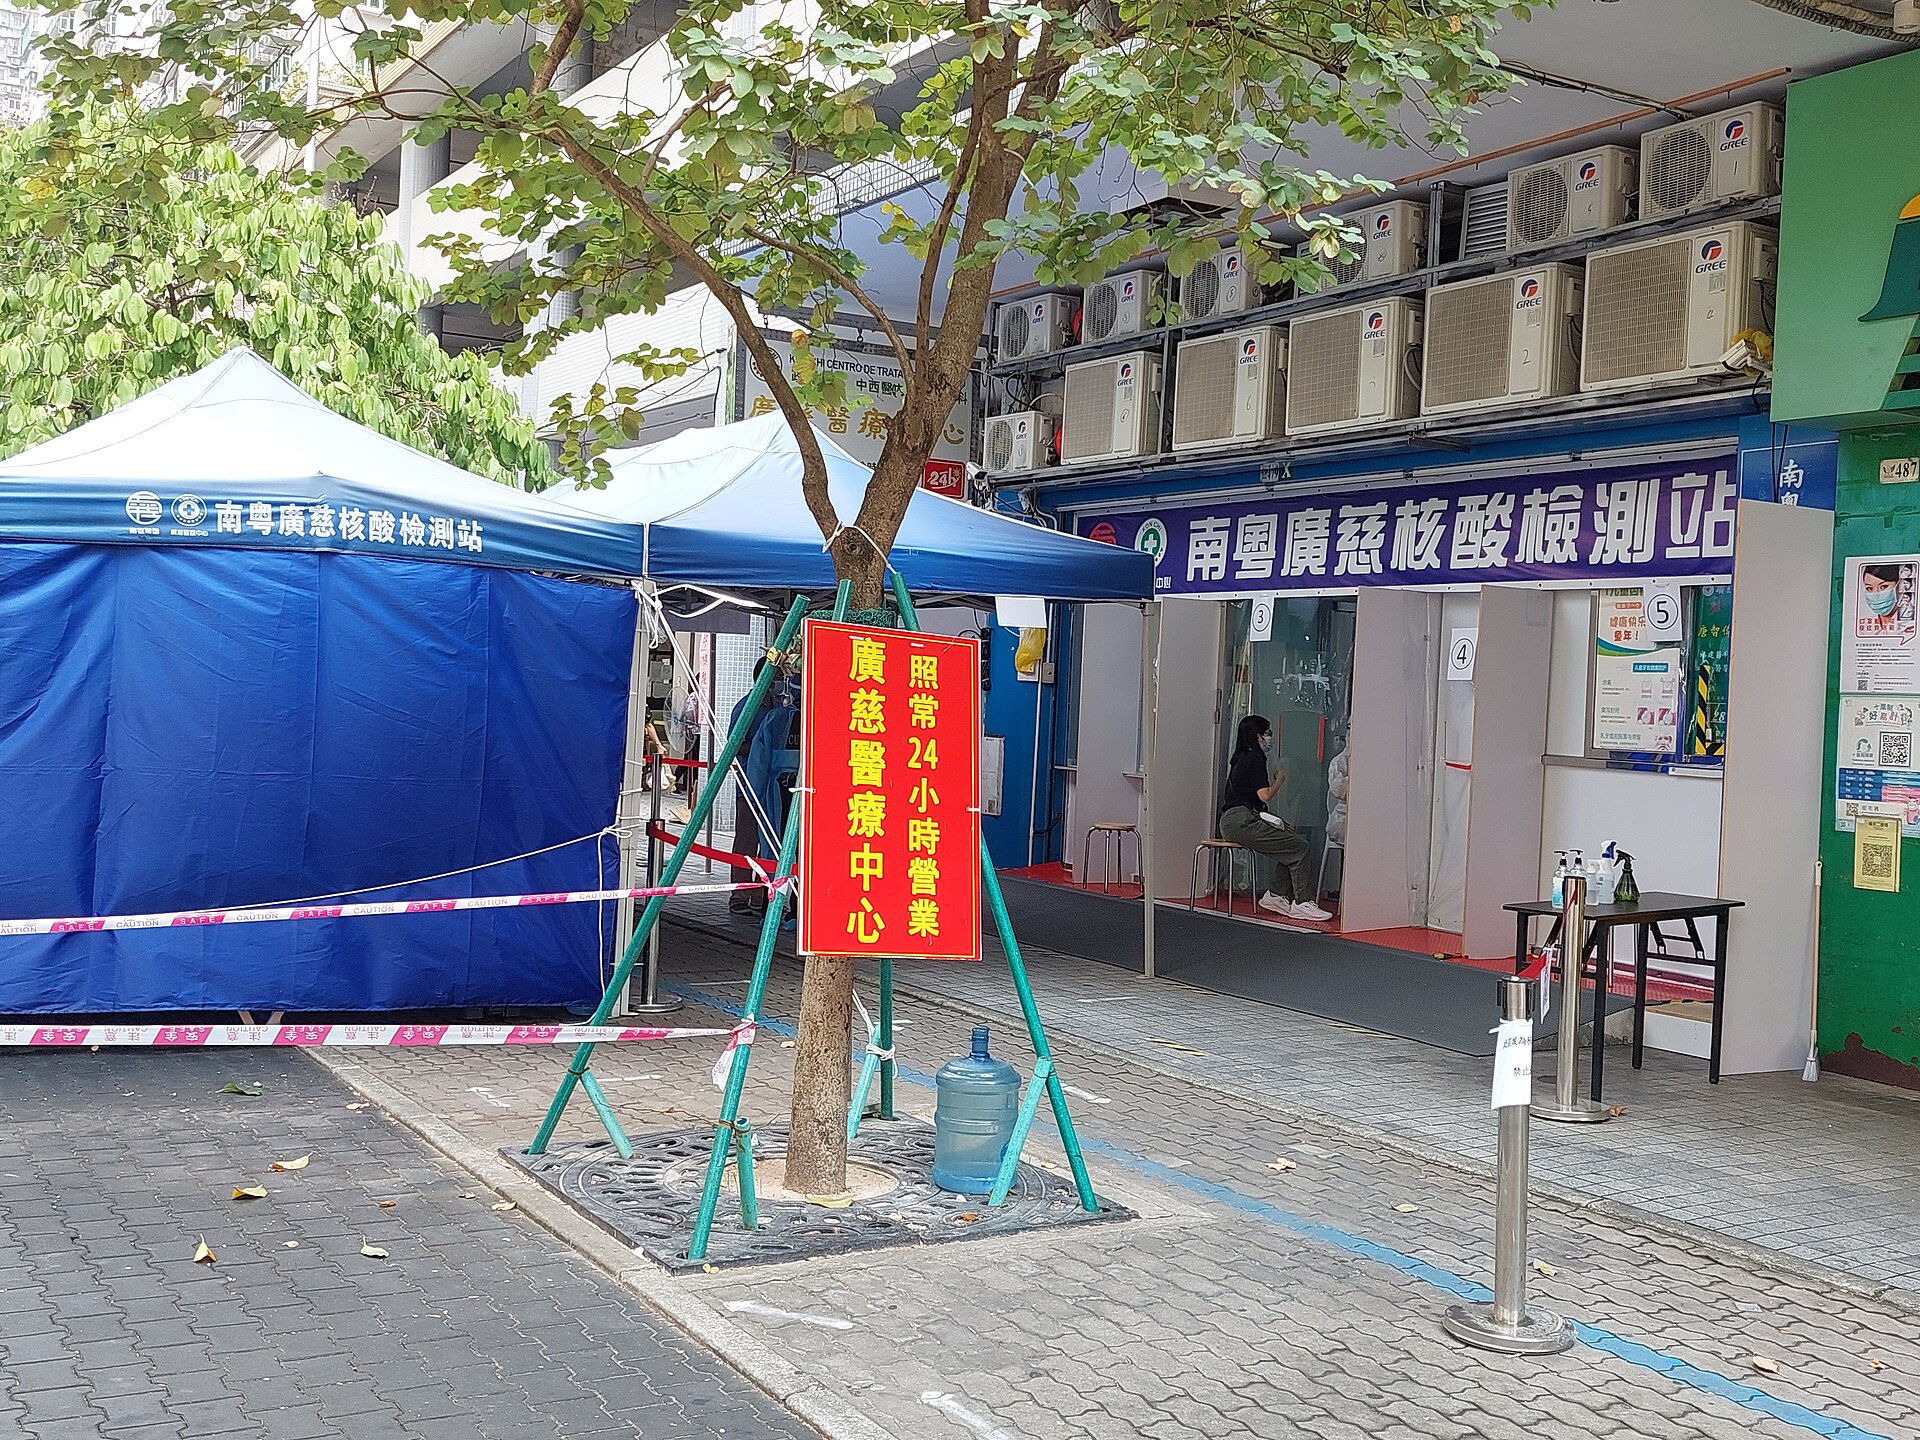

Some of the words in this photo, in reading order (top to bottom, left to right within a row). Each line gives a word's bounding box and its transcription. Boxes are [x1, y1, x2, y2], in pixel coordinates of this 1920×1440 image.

[1720, 136, 1748, 151] GREE
[1575, 178, 1599, 191] GREE
[1373, 228, 1393, 240] GREE
[1223, 269, 1239, 279] GREE
[1695, 259, 1727, 274] GREE
[1516, 296, 1543, 310] GREE
[1364, 328, 1386, 340] GREE
[1239, 354, 1259, 365] GREE
[1522, 349, 1531, 365] 2
[827, 359, 863, 373] CENTRO
[863, 364, 876, 374] DE
[1117, 377, 1133, 386] GREE
[1895, 462, 1917, 478] 487
[1257, 609, 1265, 624] 3
[1656, 601, 1669, 624] 5
[1456, 643, 1468, 665] 4
[846, 637, 887, 945] 廣慈醫療中心
[908, 655, 940, 938] 照常24小時營業
[58, 923, 95, 932] SAFE
[116, 920, 159, 928] CAUTION
[179, 916, 216, 925] SAFE
[236, 913, 279, 921] CAUTION
[299, 909, 334, 918] SAFE
[353, 905, 395, 914] CAUTION
[413, 902, 448, 911] SAFE
[467, 898, 508, 907] CAUTION
[579, 891, 619, 899] CAUTION
[42, 1031, 76, 1041] 安全
[165, 1031, 198, 1041] 安全
[285, 1031, 318, 1041] 安全
